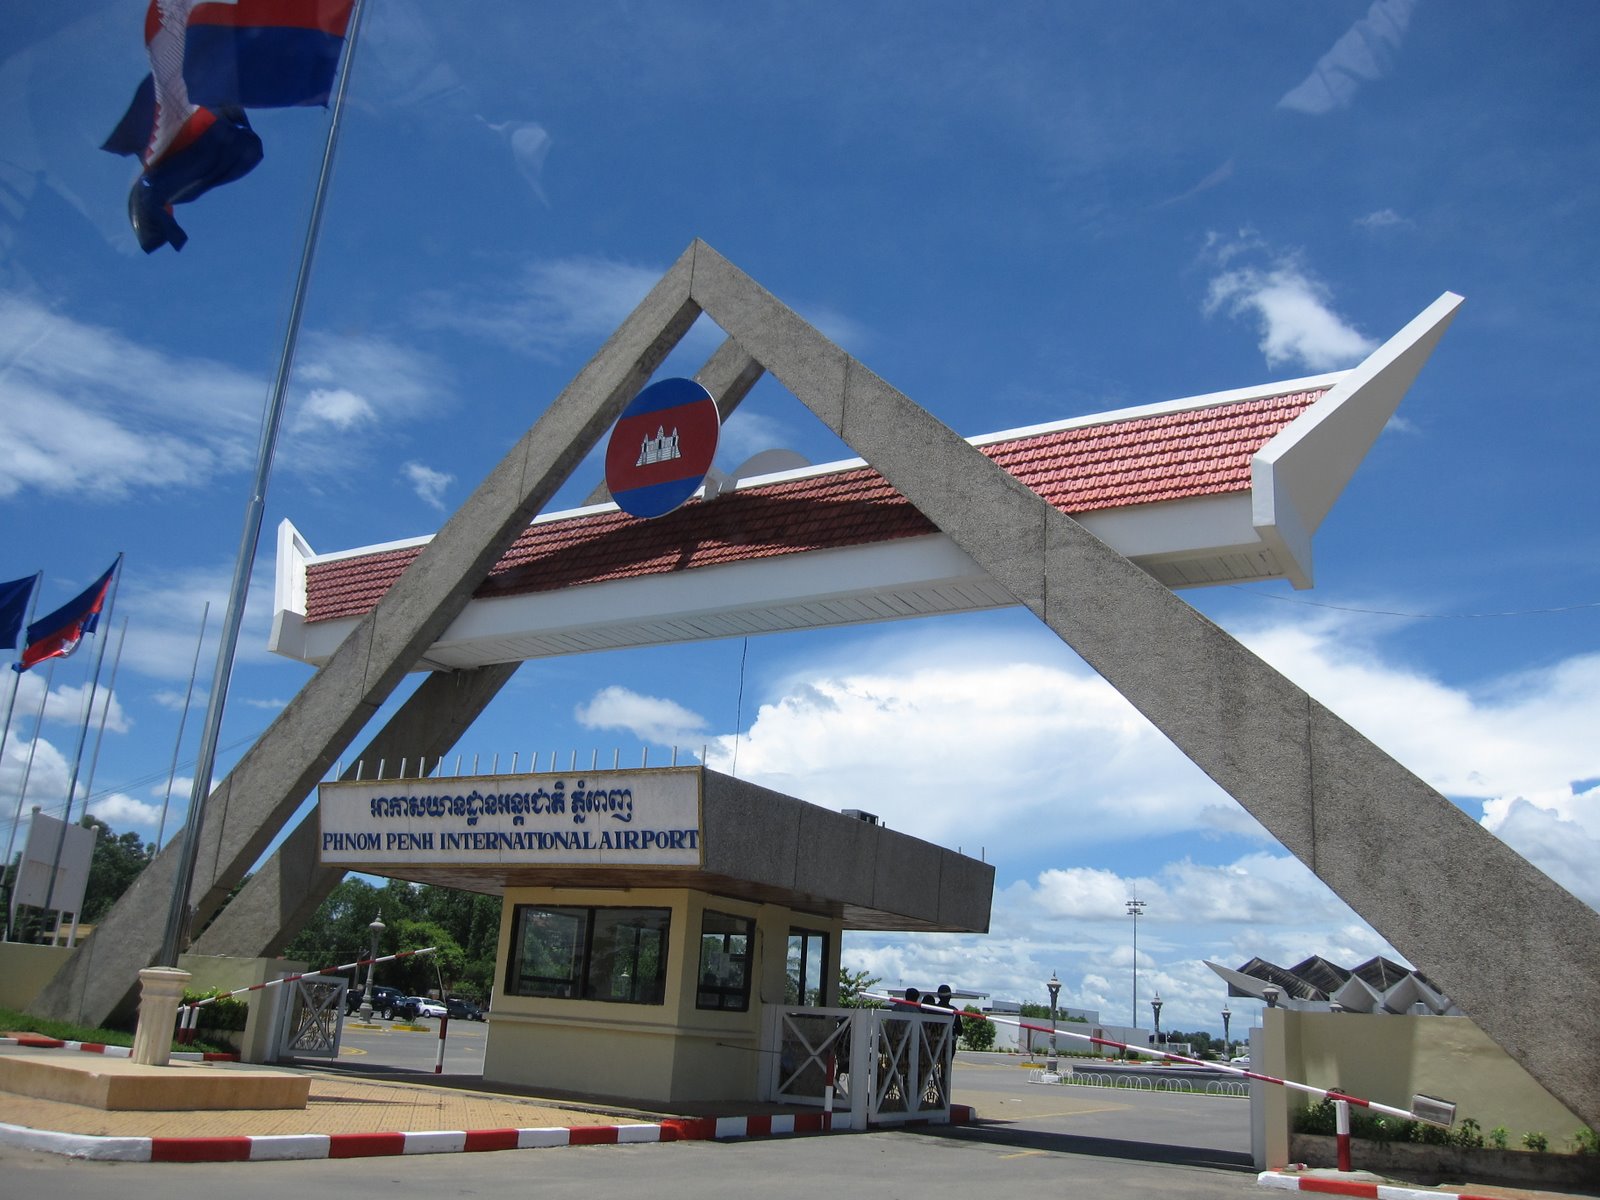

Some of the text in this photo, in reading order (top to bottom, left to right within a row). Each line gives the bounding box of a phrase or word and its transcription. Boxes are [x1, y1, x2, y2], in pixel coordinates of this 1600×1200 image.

[322, 829, 699, 851] PHNOM PENH INTERNATIONAL AIRPORT
